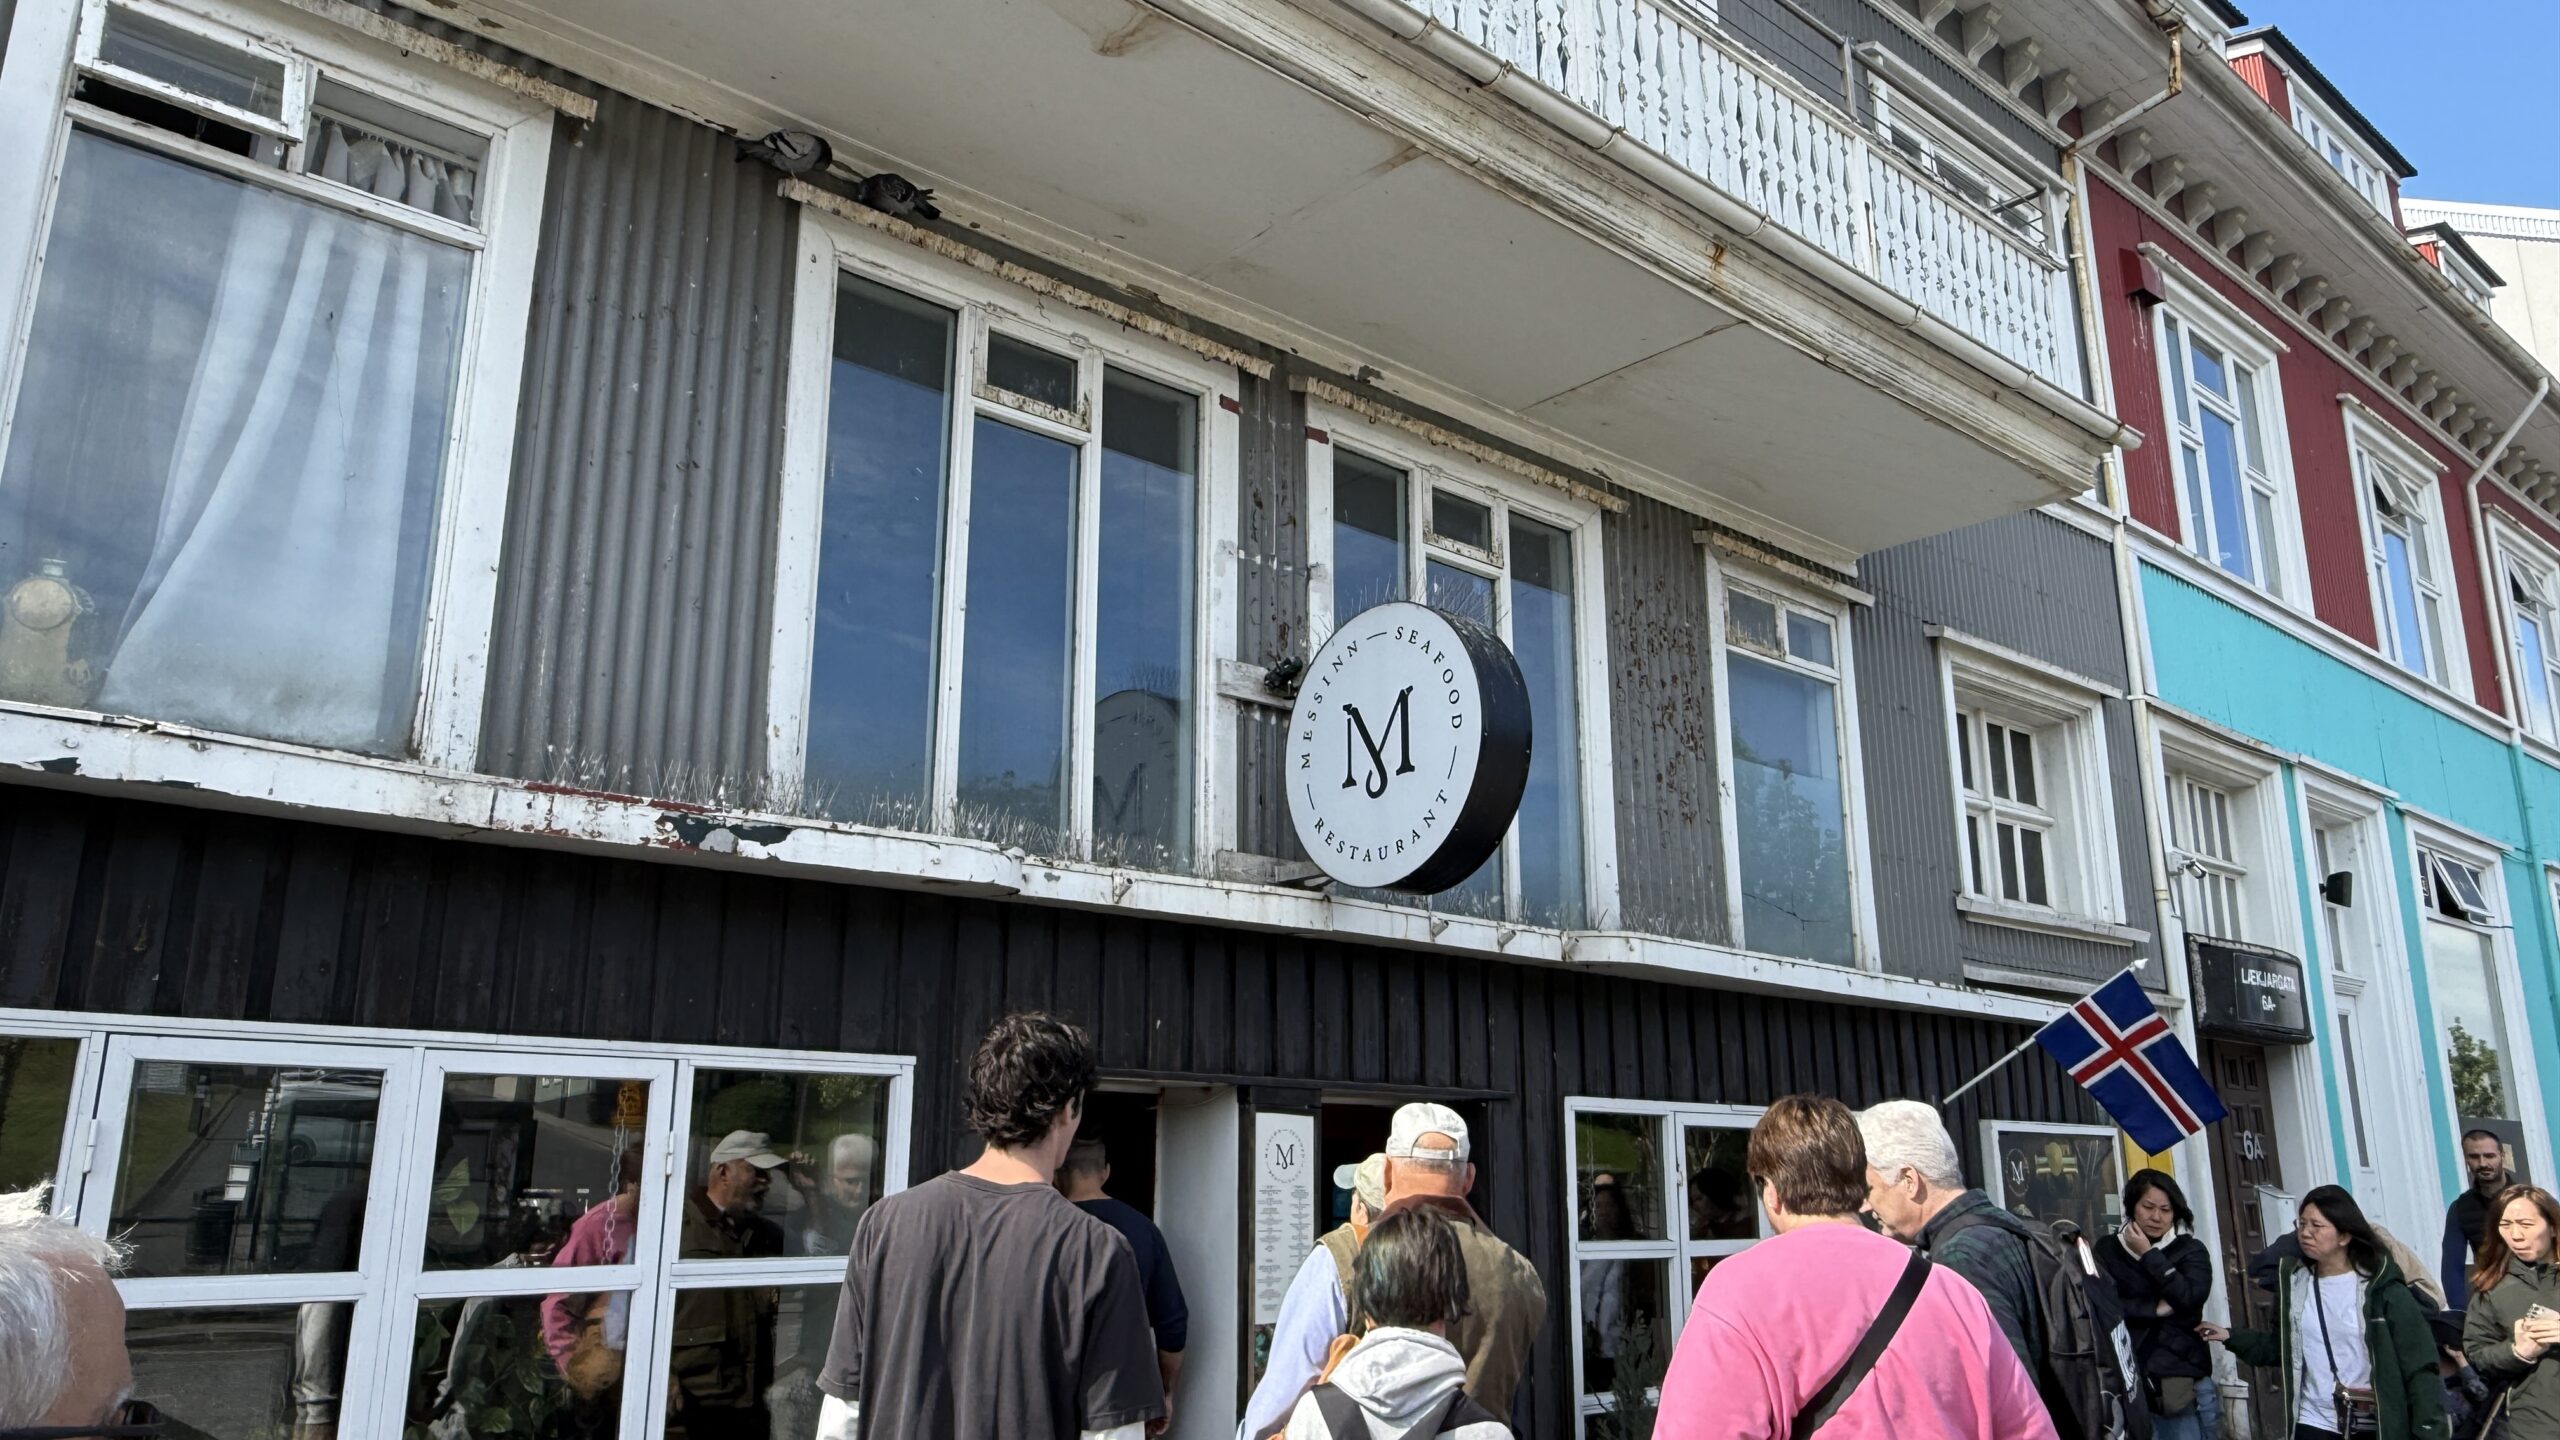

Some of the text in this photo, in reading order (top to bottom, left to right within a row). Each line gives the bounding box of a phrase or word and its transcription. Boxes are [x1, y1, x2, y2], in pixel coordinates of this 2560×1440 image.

[1301, 626, 1463, 862] MESSINN SEAFOOD RESTAURANT
[2241, 967, 2296, 993] LÆKJARGATA
[2243, 1130, 2265, 1161] 6A
